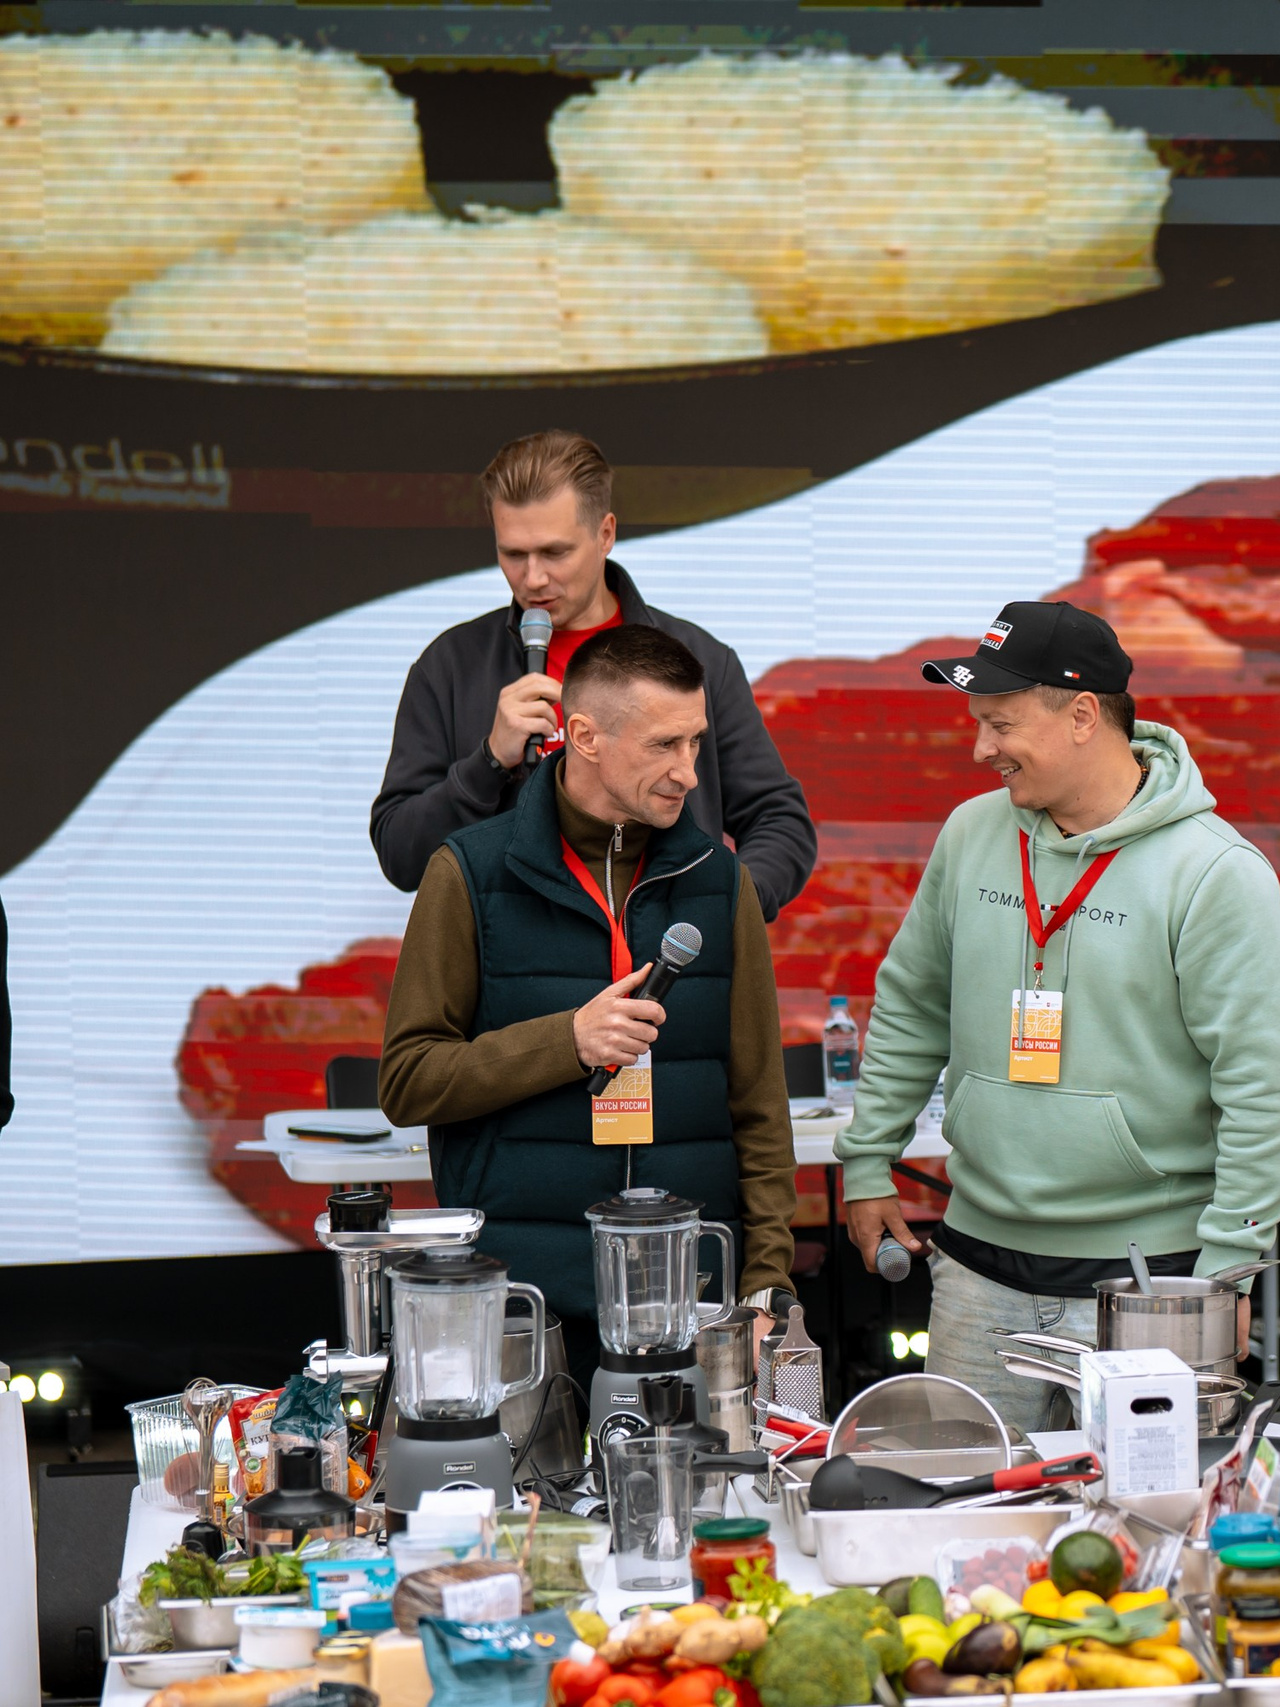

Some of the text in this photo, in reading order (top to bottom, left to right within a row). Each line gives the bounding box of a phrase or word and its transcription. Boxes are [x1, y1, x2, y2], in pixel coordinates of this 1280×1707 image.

[978, 888, 1128, 927] TOMM PORT
[1014, 1039, 1058, 1050] ВУСЫ РОССИИ
[595, 1101, 647, 1111] ВКУСЫ РОССИИ
